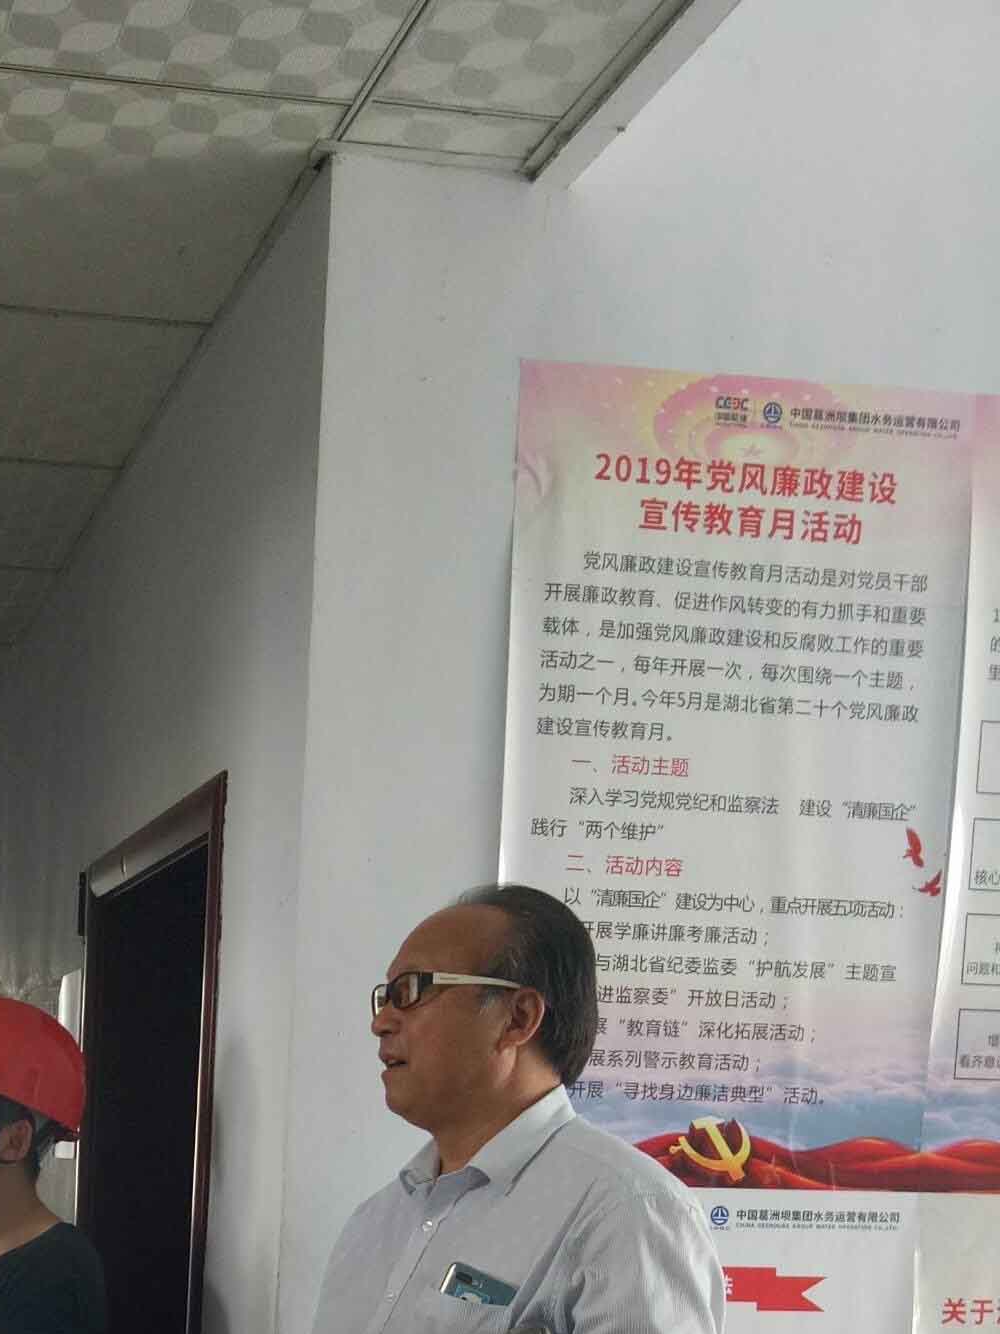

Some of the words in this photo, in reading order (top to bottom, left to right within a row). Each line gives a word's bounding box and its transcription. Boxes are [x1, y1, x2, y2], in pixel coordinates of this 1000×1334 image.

[594, 452, 898, 505] 2019年党风廉政建设
[638, 497, 863, 545] 宣传教育月活动
[584, 551, 928, 593] 党风廉政建设宣传教育月活动是对党员干部
[571, 755, 690, 778] 一、活动主题
[565, 854, 683, 877] 二、活动内容
[736, 1208, 900, 1223] 中国葛洲坝集团水务运营有限公司
[941, 1297, 1000, 1325] 关于
